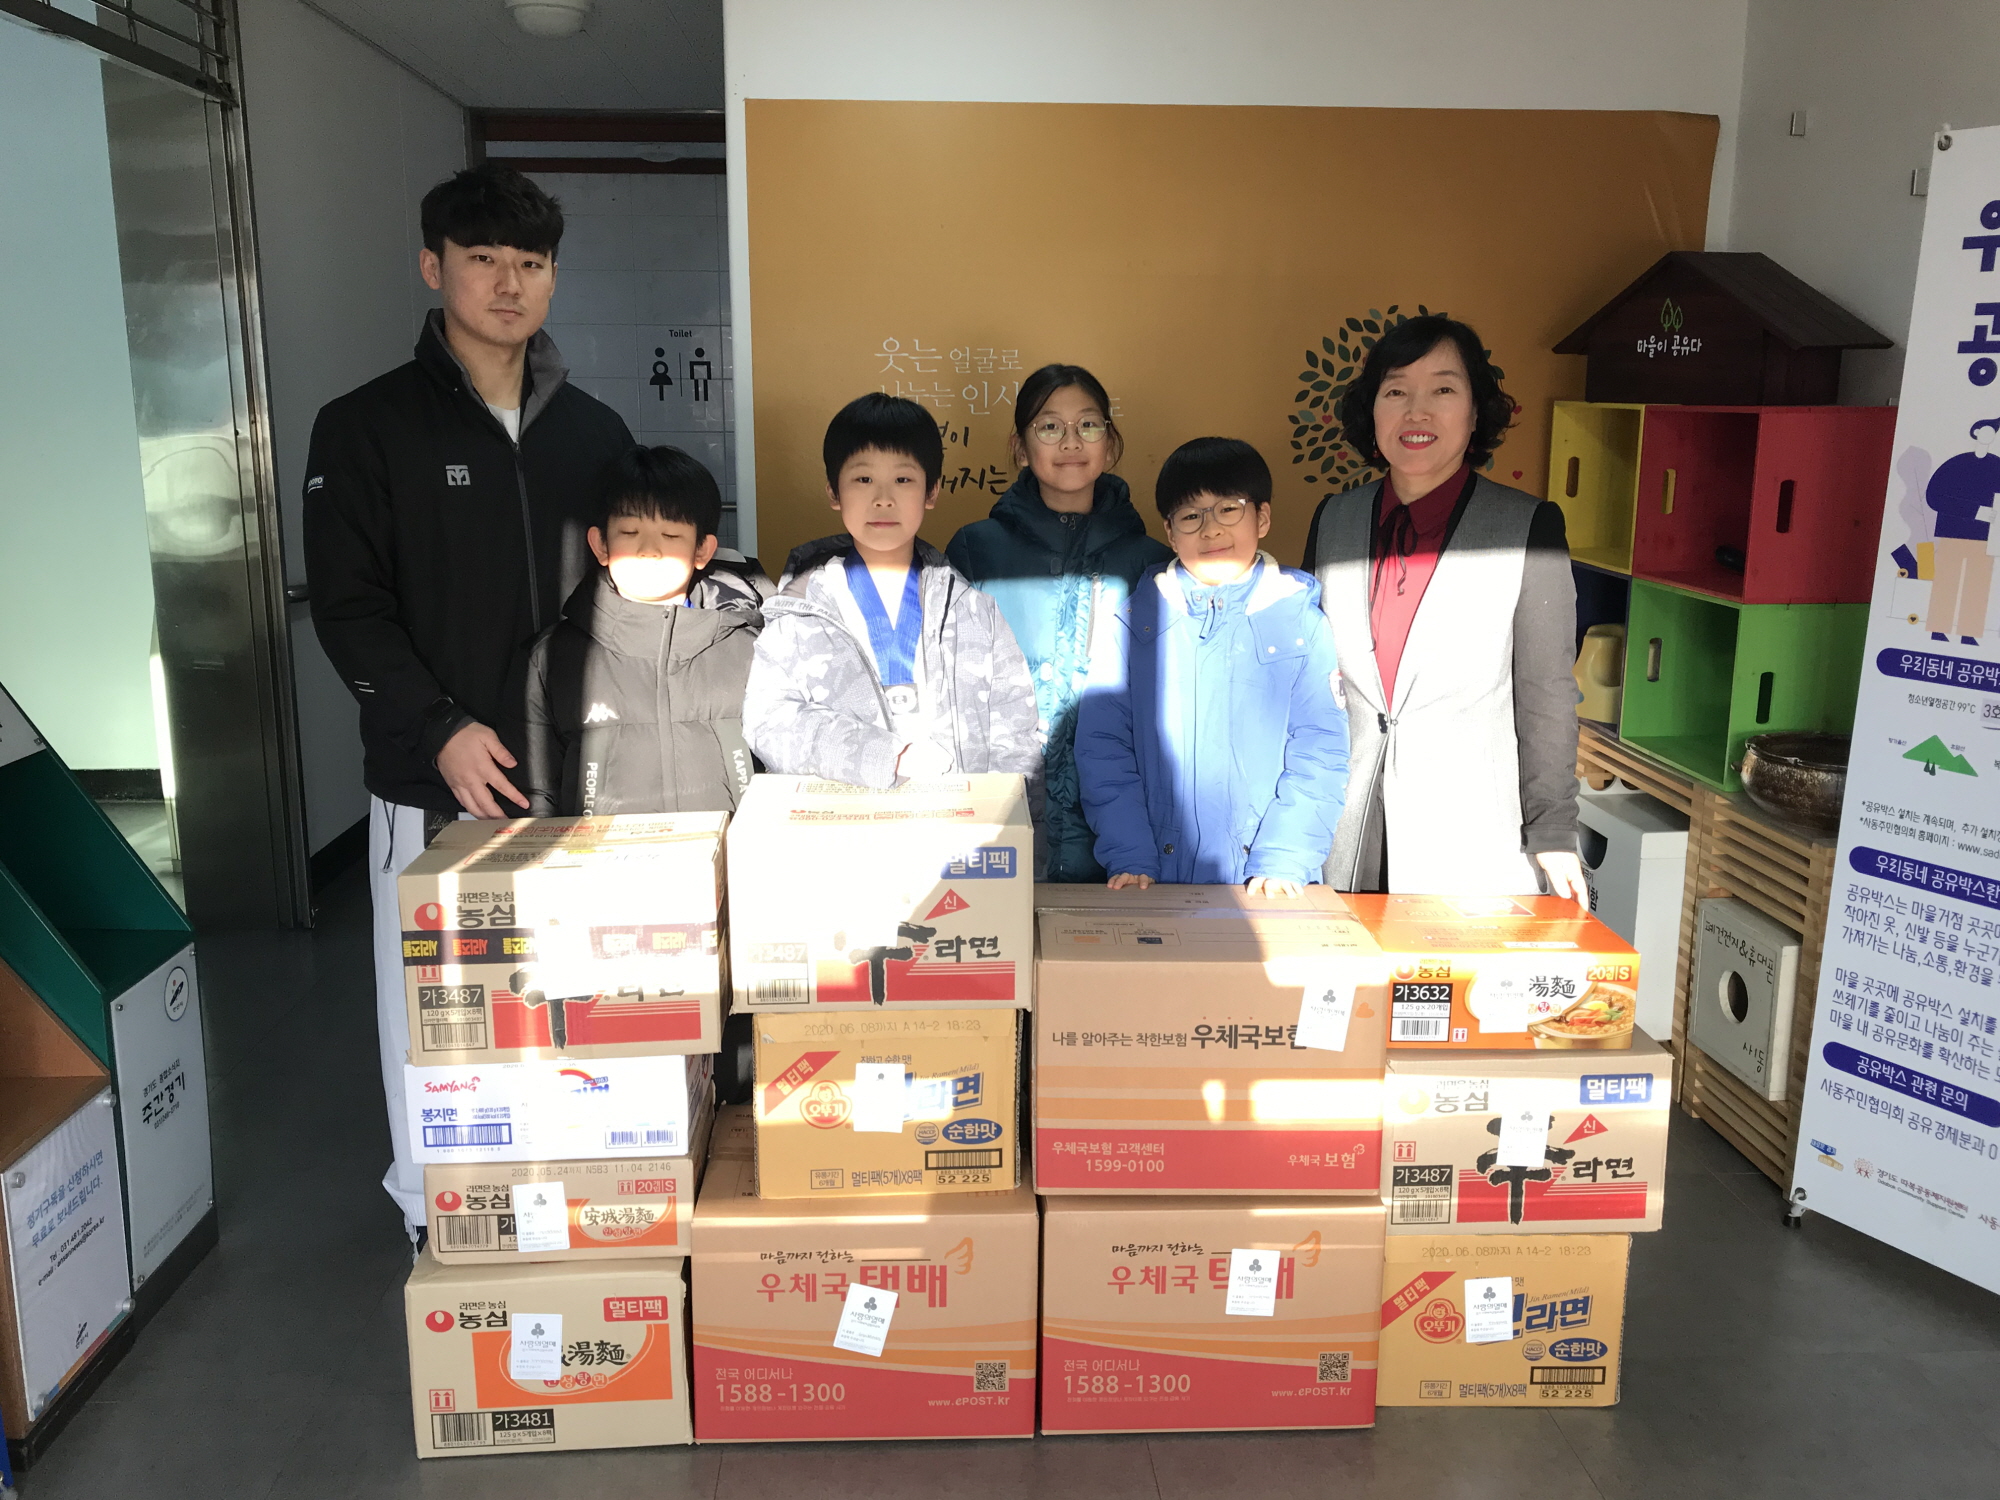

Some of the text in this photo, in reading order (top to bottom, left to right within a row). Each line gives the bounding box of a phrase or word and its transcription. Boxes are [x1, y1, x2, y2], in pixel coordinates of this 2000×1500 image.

[668, 329, 693, 338] Toilet
[1637, 335, 1702, 358] 마을이 공유다
[875, 337, 1023, 374] 웃는 얼굴로
[798, 602, 814, 611] THE
[1900, 655, 1954, 680] 우리동네
[732, 749, 750, 793] KAPPA
[583, 762, 598, 808] PEOPLE
[1918, 830, 1949, 847] 홈페이지
[949, 851, 1010, 874] 멀티팩
[1876, 855, 1928, 885] 우리동네
[457, 891, 515, 903] 라면은 농심
[944, 896, 957, 910] 신
[457, 904, 516, 928] 농심
[1847, 884, 1964, 931] 공유박스는 마을거점
[1844, 905, 1960, 953] 작아진 옷, 신발 등을
[1842, 925, 1890, 955] 가져가는
[935, 936, 1001, 963] 라면
[1418, 966, 1450, 979] 농심
[422, 989, 481, 1006] 가3487
[1395, 984, 1450, 1001] 가3632
[1835, 967, 1997, 1035] 마을 곳곳에 공유박스 설치를
[903, 1021, 910, 1031] A
[913, 1021, 940, 1031] 14-2
[947, 1020, 981, 1031] 18:23
[1832, 988, 1994, 1058] 쓰레기를 줄이고 나눔이 주는
[1052, 1032, 1187, 1047] 나를 알아주는 착한보험
[1829, 1009, 1991, 1081] 마을 내 공유문화를 확산하는
[1742, 1041, 1765, 1073] 사동
[776, 1058, 814, 1096] 멀티팩
[1856, 1055, 1969, 1112] 공유박스 관련 문의
[424, 1079, 478, 1093] SAMYANG
[1587, 1077, 1647, 1100] 멀티팩
[142, 1072, 185, 1125] 주간경기
[1434, 1091, 1489, 1113] 농심
[1820, 1078, 1905, 1124] 사동주민협의회
[421, 1108, 458, 1123] 봉지면
[808, 1103, 844, 1119] 오뚜기
[948, 1123, 996, 1140] 순한맛
[1583, 1120, 1596, 1134] 신
[1052, 1143, 1165, 1156] 우체국보험 고객센터
[614, 1164, 643, 1173] 11.04
[648, 1162, 671, 1172] 2146
[1086, 1160, 1164, 1173] 1599-0100
[1288, 1153, 1356, 1169] 우체국 보험
[1573, 1157, 1635, 1182] 라면
[1396, 1168, 1450, 1184] 가3487
[27, 1150, 104, 1230] 정기구독을 신청하시면
[466, 1184, 510, 1193] 라면은 농심
[665, 1180, 674, 1192] S
[465, 1193, 511, 1211] 농심
[32, 1175, 103, 1248] 무료로 보내드립니다.
[584, 1207, 655, 1226] 安城湯麵
[760, 1249, 854, 1265] 마음까지 전하는
[1111, 1242, 1204, 1257] 마음까지 전하는
[1516, 1246, 1523, 1256] A
[1526, 1246, 1552, 1256] 14-2
[1558, 1246, 1591, 1256] 18:23
[756, 1272, 850, 1303] 우체국
[1108, 1266, 1199, 1294] 우체국
[1393, 1278, 1431, 1311] 멀티팩
[1541, 1286, 1590, 1301] Ramen(Mild)
[459, 1301, 507, 1310] 라면은 농심
[609, 1299, 663, 1318] 멀티팩
[459, 1311, 508, 1329] 농심
[1423, 1321, 1456, 1333] 오뚜기
[1555, 1342, 1602, 1357] 순한맛
[715, 1367, 794, 1380] 전국 어디서나
[1063, 1359, 1140, 1372] 전국 어디서나
[1272, 1386, 1351, 1397] www.ePOST.kr
[928, 1395, 1010, 1407] www.ePOST.kr
[495, 1412, 551, 1429] 가3481
